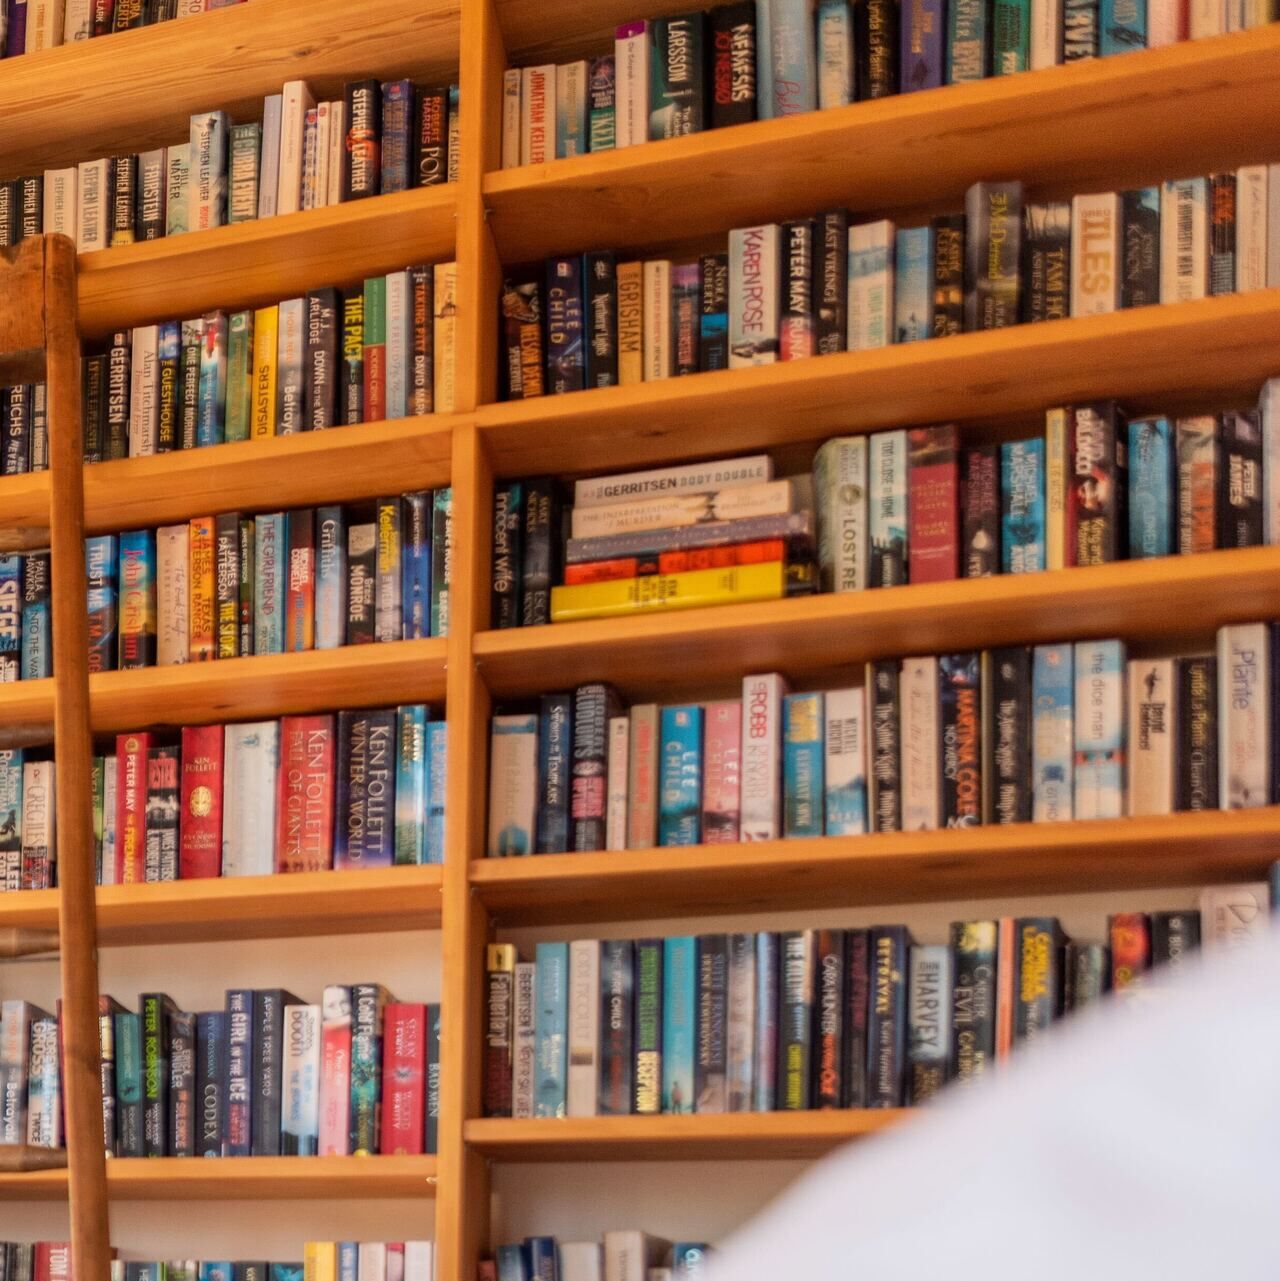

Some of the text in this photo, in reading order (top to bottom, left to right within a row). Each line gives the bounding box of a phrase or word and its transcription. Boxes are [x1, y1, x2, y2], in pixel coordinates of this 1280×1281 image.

[667, 20, 689, 83] LARSSON
[730, 24, 755, 103] NEMESIS
[350, 89, 367, 192] STEPHEN LEATHER
[420, 97, 431, 145] HARRIS
[431, 97, 442, 142] ROBERT
[529, 71, 546, 165] JONATHAN KELLER
[53, 177, 65, 211] STEPHEN
[115, 158, 129, 229] STEPHEN LEATHER
[142, 165, 160, 222] FAIRSTEIN
[169, 159, 181, 200] NAPIER
[180, 167, 189, 187] BILL
[199, 131, 210, 201] STEPHEN LEATHER
[23, 180, 37, 215] STEPHEN
[82, 166, 99, 243] STEPHEN LEATHER
[231, 182, 255, 217] EVENT
[823, 220, 839, 250] LAST
[1080, 219, 1112, 297] ILES
[740, 228, 764, 336] KAREN ROSE
[788, 225, 806, 315] PETER MAY
[1045, 248, 1065, 294] TAMI
[308, 296, 321, 345] ARLIDGE
[344, 296, 363, 361] THE PACT
[549, 287, 565, 345] CHILD
[565, 297, 580, 331] LEE
[619, 281, 642, 354] GRISHAM
[313, 350, 326, 384] DOWN
[414, 354, 425, 386] DAVID
[508, 346, 522, 393] SPENCERVILLE
[520, 323, 541, 365] NELSON
[8, 385, 24, 436] REICHS
[108, 346, 127, 424] GERRITSEN
[140, 349, 156, 452] Alan Titchmarsh
[160, 367, 174, 443] GUESTHOUSE
[183, 346, 197, 450] ONE PERFECT MORNING
[257, 365, 270, 436] DISASTERS
[603, 477, 678, 499] GERRITSEN
[1229, 455, 1244, 506] JAMES
[1243, 460, 1256, 498] PETER
[379, 505, 397, 574] Kellerman
[493, 492, 514, 593] innocent wife
[506, 512, 520, 531] the
[842, 519, 858, 565] LOST
[24, 555, 37, 602] HAWKINS
[33, 560, 45, 592] PAULA
[87, 543, 104, 611] TRUST ME
[191, 525, 204, 640] PATTERSON RANGER
[216, 537, 230, 601] PATTERSON
[226, 550, 238, 588] JAMES
[261, 520, 276, 616] THE GIRLFRIEND
[349, 564, 365, 623] MONROE
[28, 637, 40, 657] THE
[1090, 654, 1106, 741] the dice man
[1231, 650, 1257, 711] Plante
[749, 692, 768, 740] ROBB
[843, 718, 859, 756] MICHAEL
[943, 724, 957, 745] NO
[547, 756, 564, 805] TEMPLARS
[665, 741, 681, 803] CHILD
[682, 752, 697, 787] LEE
[955, 689, 978, 815] MARTINA COLE
[1191, 751, 1205, 787] Clean
[125, 754, 137, 811] PETER MAY
[305, 728, 328, 856] KEN FOLLETT
[348, 720, 366, 861] WINTER WORLD
[366, 726, 389, 854] KEN FOLLETT
[287, 768, 302, 857] OF GIANTS
[518, 972, 534, 1028] GERRITSEN
[820, 953, 840, 1036] CARA HUNTER
[875, 937, 893, 1015] BETRAYAL
[230, 1012, 248, 1046] GIRL
[485, 972, 511, 1048] Fatherland
[610, 996, 623, 1031] CHILD
[917, 972, 940, 1048] HARVEY
[145, 998, 161, 1099] PETER ROBINSON
[171, 1037, 185, 1089] SPINDLER
[262, 995, 274, 1098] APPLE TREE YARD
[228, 1077, 248, 1102] ICE
[636, 1051, 659, 1113] DECEPTION
[31, 1111, 43, 1143] TWICE
[203, 1082, 219, 1141] CODEX
[48, 1246, 69, 1276] TOM
